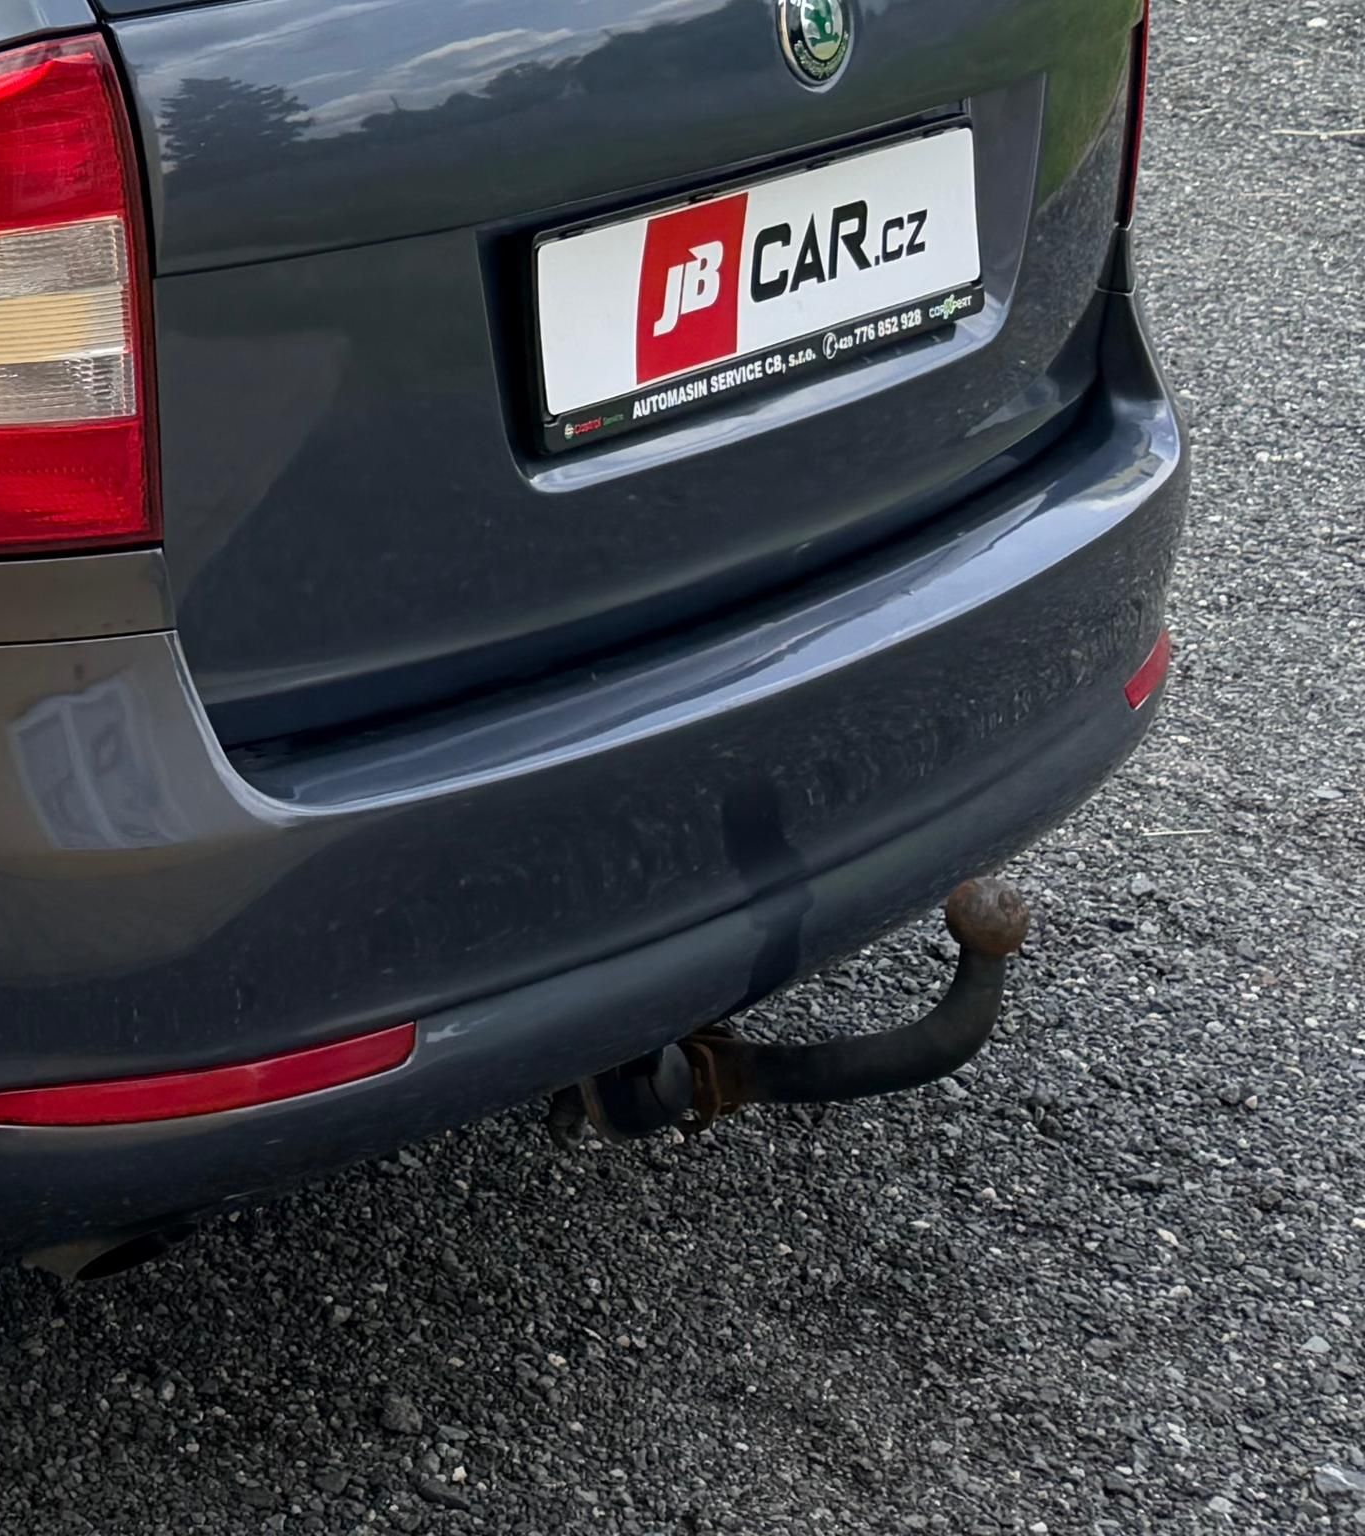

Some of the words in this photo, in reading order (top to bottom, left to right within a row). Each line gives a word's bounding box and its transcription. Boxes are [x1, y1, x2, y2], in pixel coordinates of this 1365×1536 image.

[632, 377, 708, 420] AUTOMASIN
[710, 360, 764, 393] SERVICE
[765, 354, 787, 374] CB,
[788, 348, 816, 367] s.r.o.
[854, 323, 875, 345] 776
[877, 316, 899, 338] 852
[900, 308, 922, 330] 928
